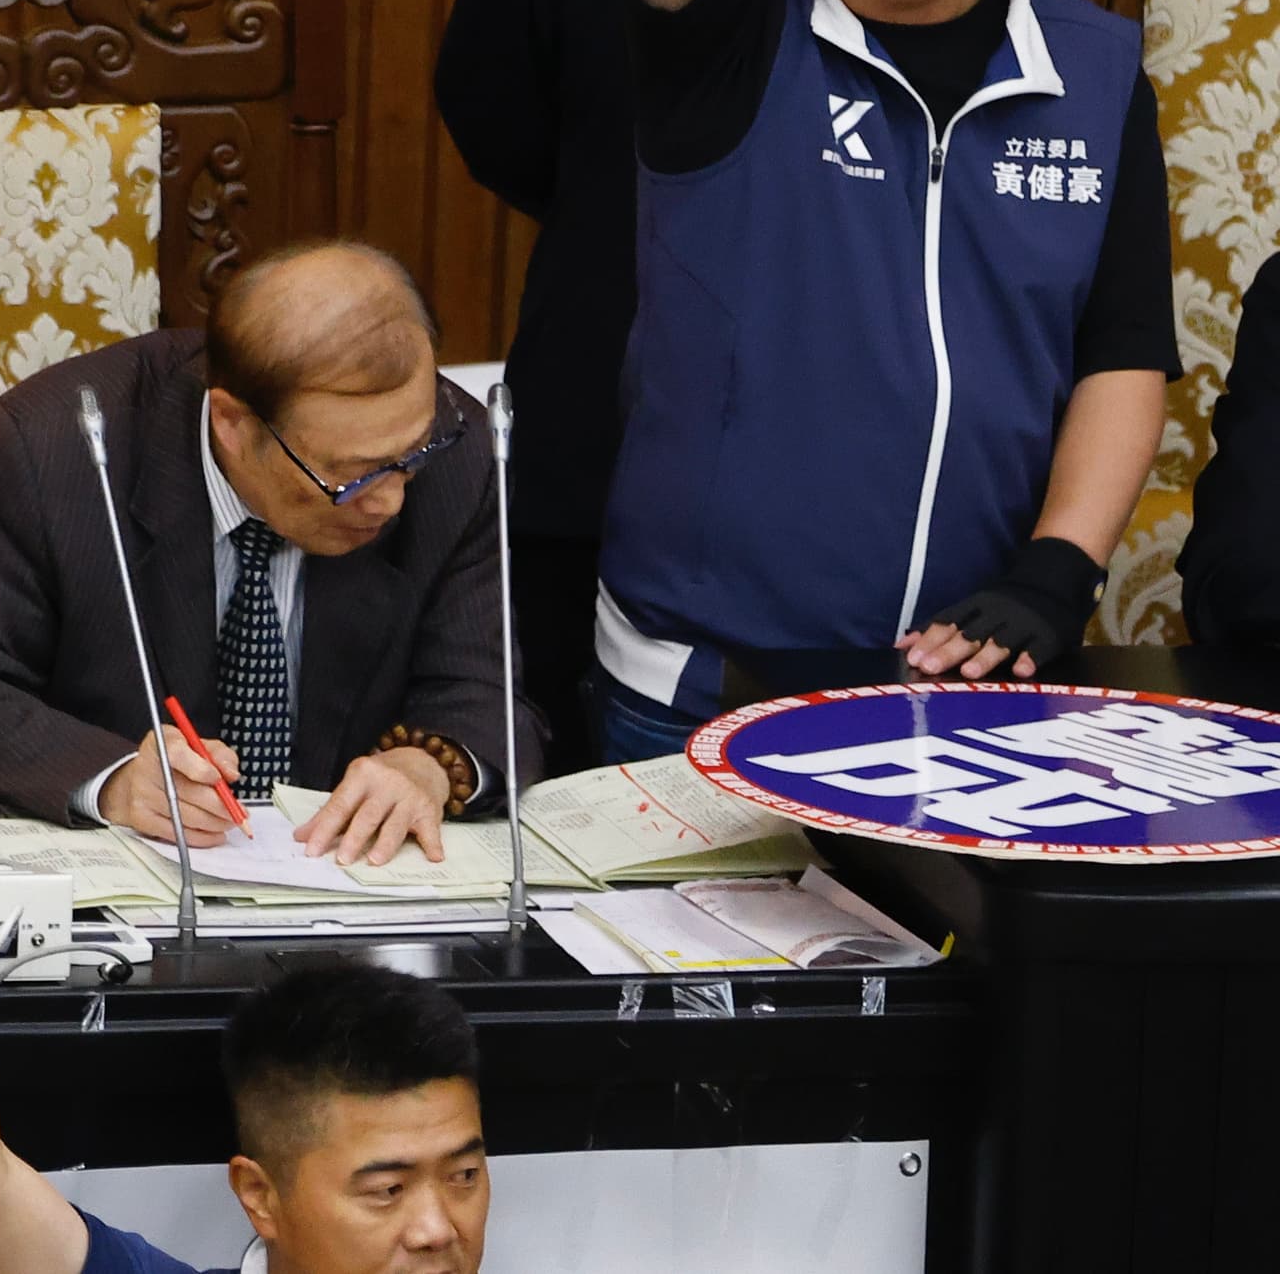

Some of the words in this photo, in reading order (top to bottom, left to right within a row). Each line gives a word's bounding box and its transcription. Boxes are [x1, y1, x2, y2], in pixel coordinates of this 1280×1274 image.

[1004, 137, 1088, 160] 立法委員
[992, 160, 1102, 204] 黃健豪
